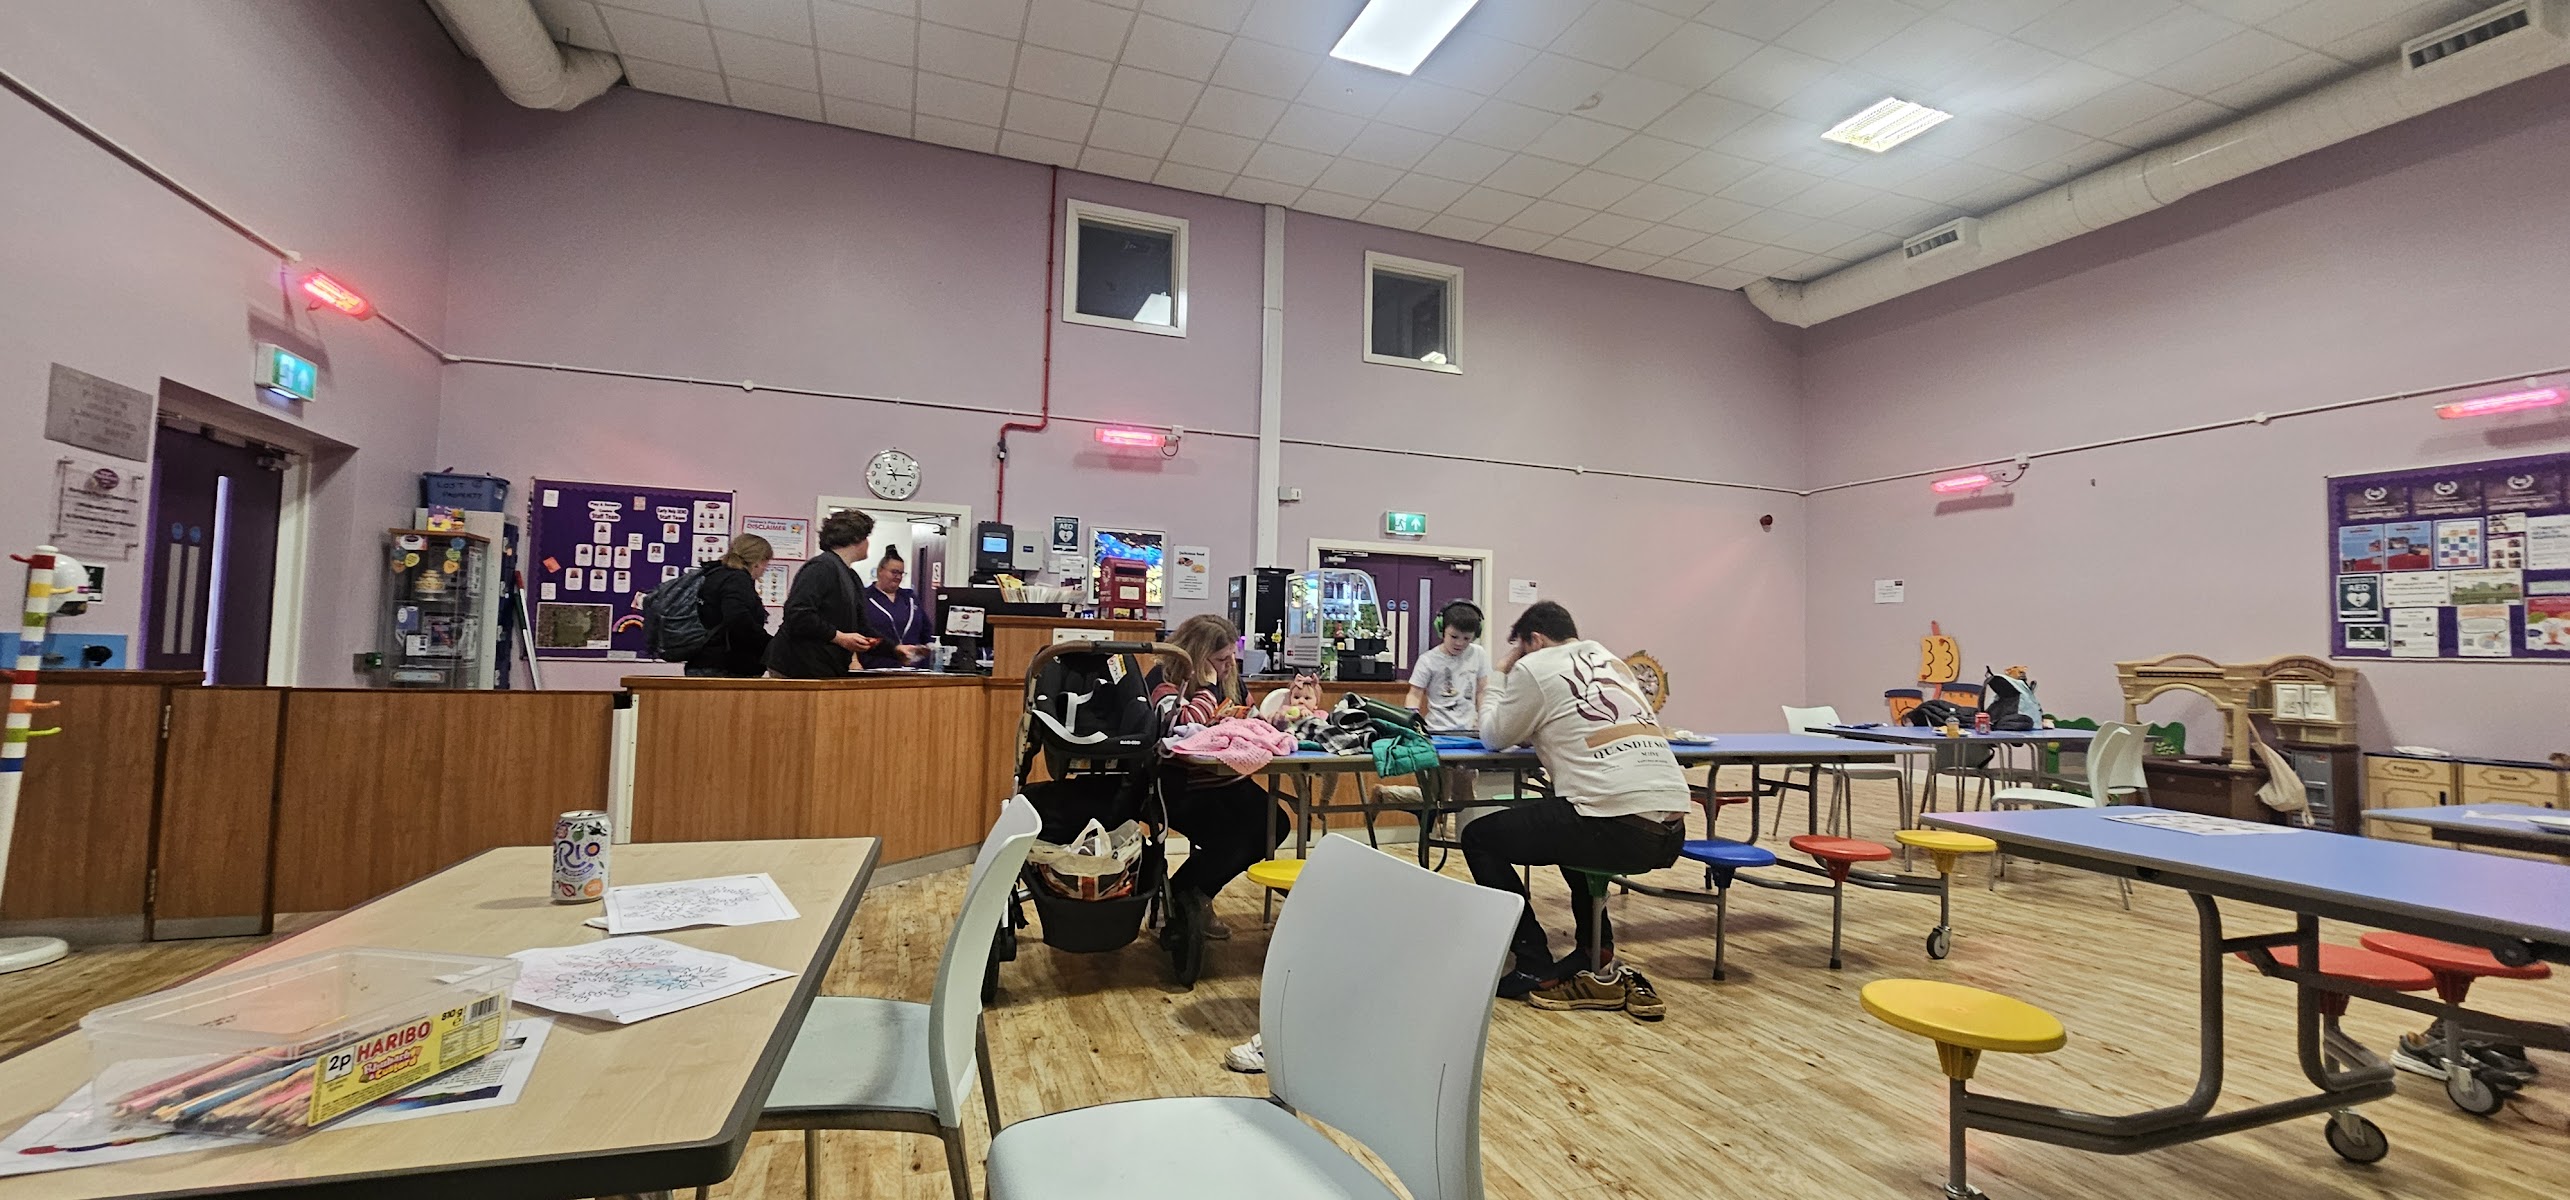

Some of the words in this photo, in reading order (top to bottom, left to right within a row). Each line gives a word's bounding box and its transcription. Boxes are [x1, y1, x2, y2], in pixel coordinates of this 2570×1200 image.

[747, 523, 786, 531] DISCLAIMER
[2347, 583, 2370, 592] AED
[1593, 740, 1641, 759] QUAND
[558, 840, 601, 868] RIO
[441, 1009, 456, 1021] 810
[457, 1008, 464, 1018] g
[356, 1020, 431, 1063] HARIBO
[328, 1054, 351, 1072] 2p
[364, 1050, 411, 1074] Rhubarb
